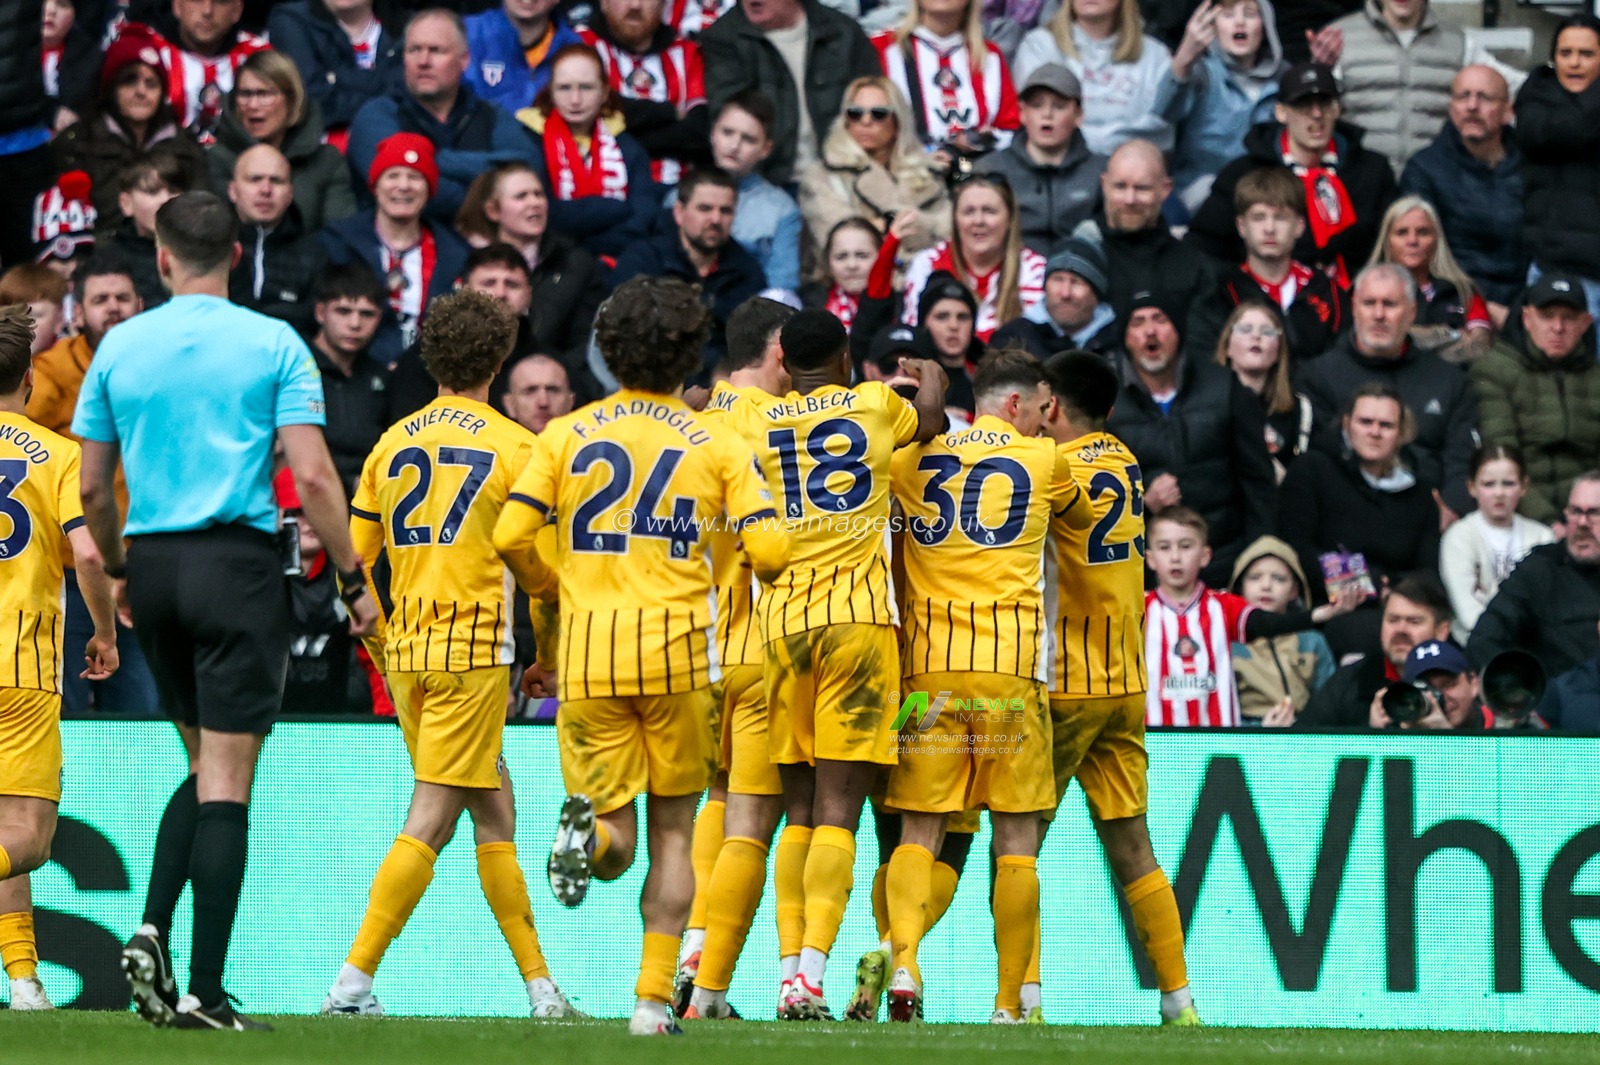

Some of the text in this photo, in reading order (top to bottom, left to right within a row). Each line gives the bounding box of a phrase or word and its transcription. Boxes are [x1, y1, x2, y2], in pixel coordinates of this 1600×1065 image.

[403, 408, 487, 437] WIEFFER
[766, 391, 857, 420] WELBECK
[387, 445, 496, 548] 27
[570, 440, 699, 560] 24
[767, 417, 873, 519] 18
[908, 453, 1032, 548] 30
[1087, 464, 1145, 566] 25
